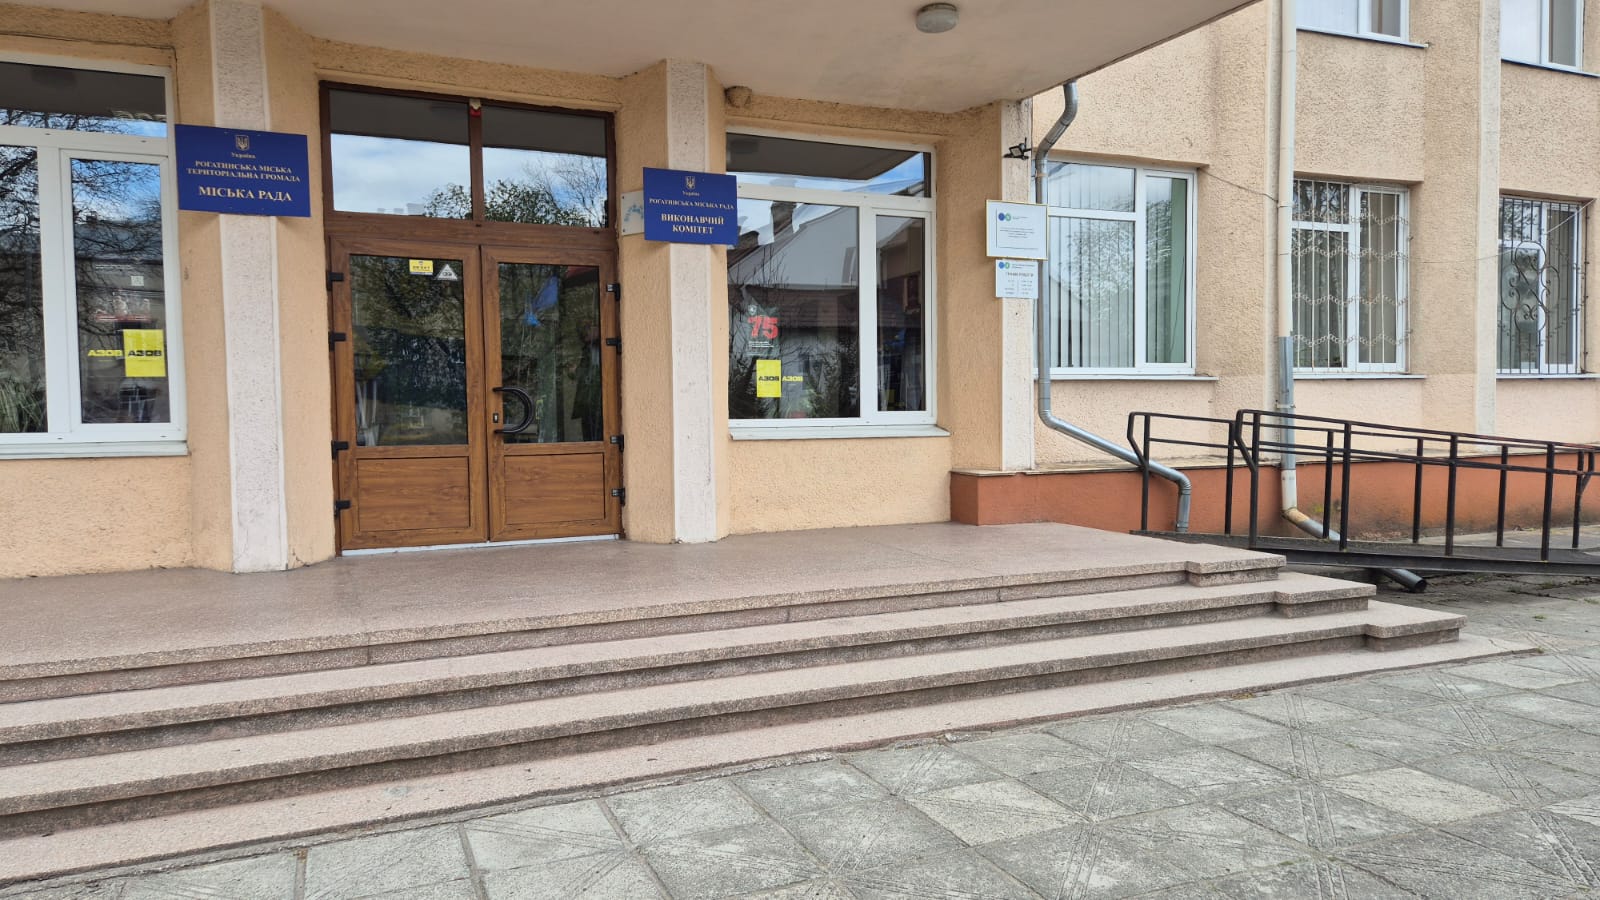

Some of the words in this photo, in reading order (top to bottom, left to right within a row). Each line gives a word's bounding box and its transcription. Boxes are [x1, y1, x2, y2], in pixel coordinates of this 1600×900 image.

[195, 160, 257, 171] РОГАТИНСЬКА
[259, 165, 292, 173] МІСЬКА
[186, 168, 259, 179] ТЕРИТОРІАЛЬНА
[260, 174, 301, 182] ГРОМАДА
[198, 186, 255, 199] МІСЬКА
[258, 190, 292, 202] РАДА
[649, 198, 694, 207] РОГАТИНСЬКА
[661, 213, 724, 225] ВИКОНАВЧИЙ
[672, 224, 714, 234] КОМІТЕТ
[748, 315, 779, 339] 75
